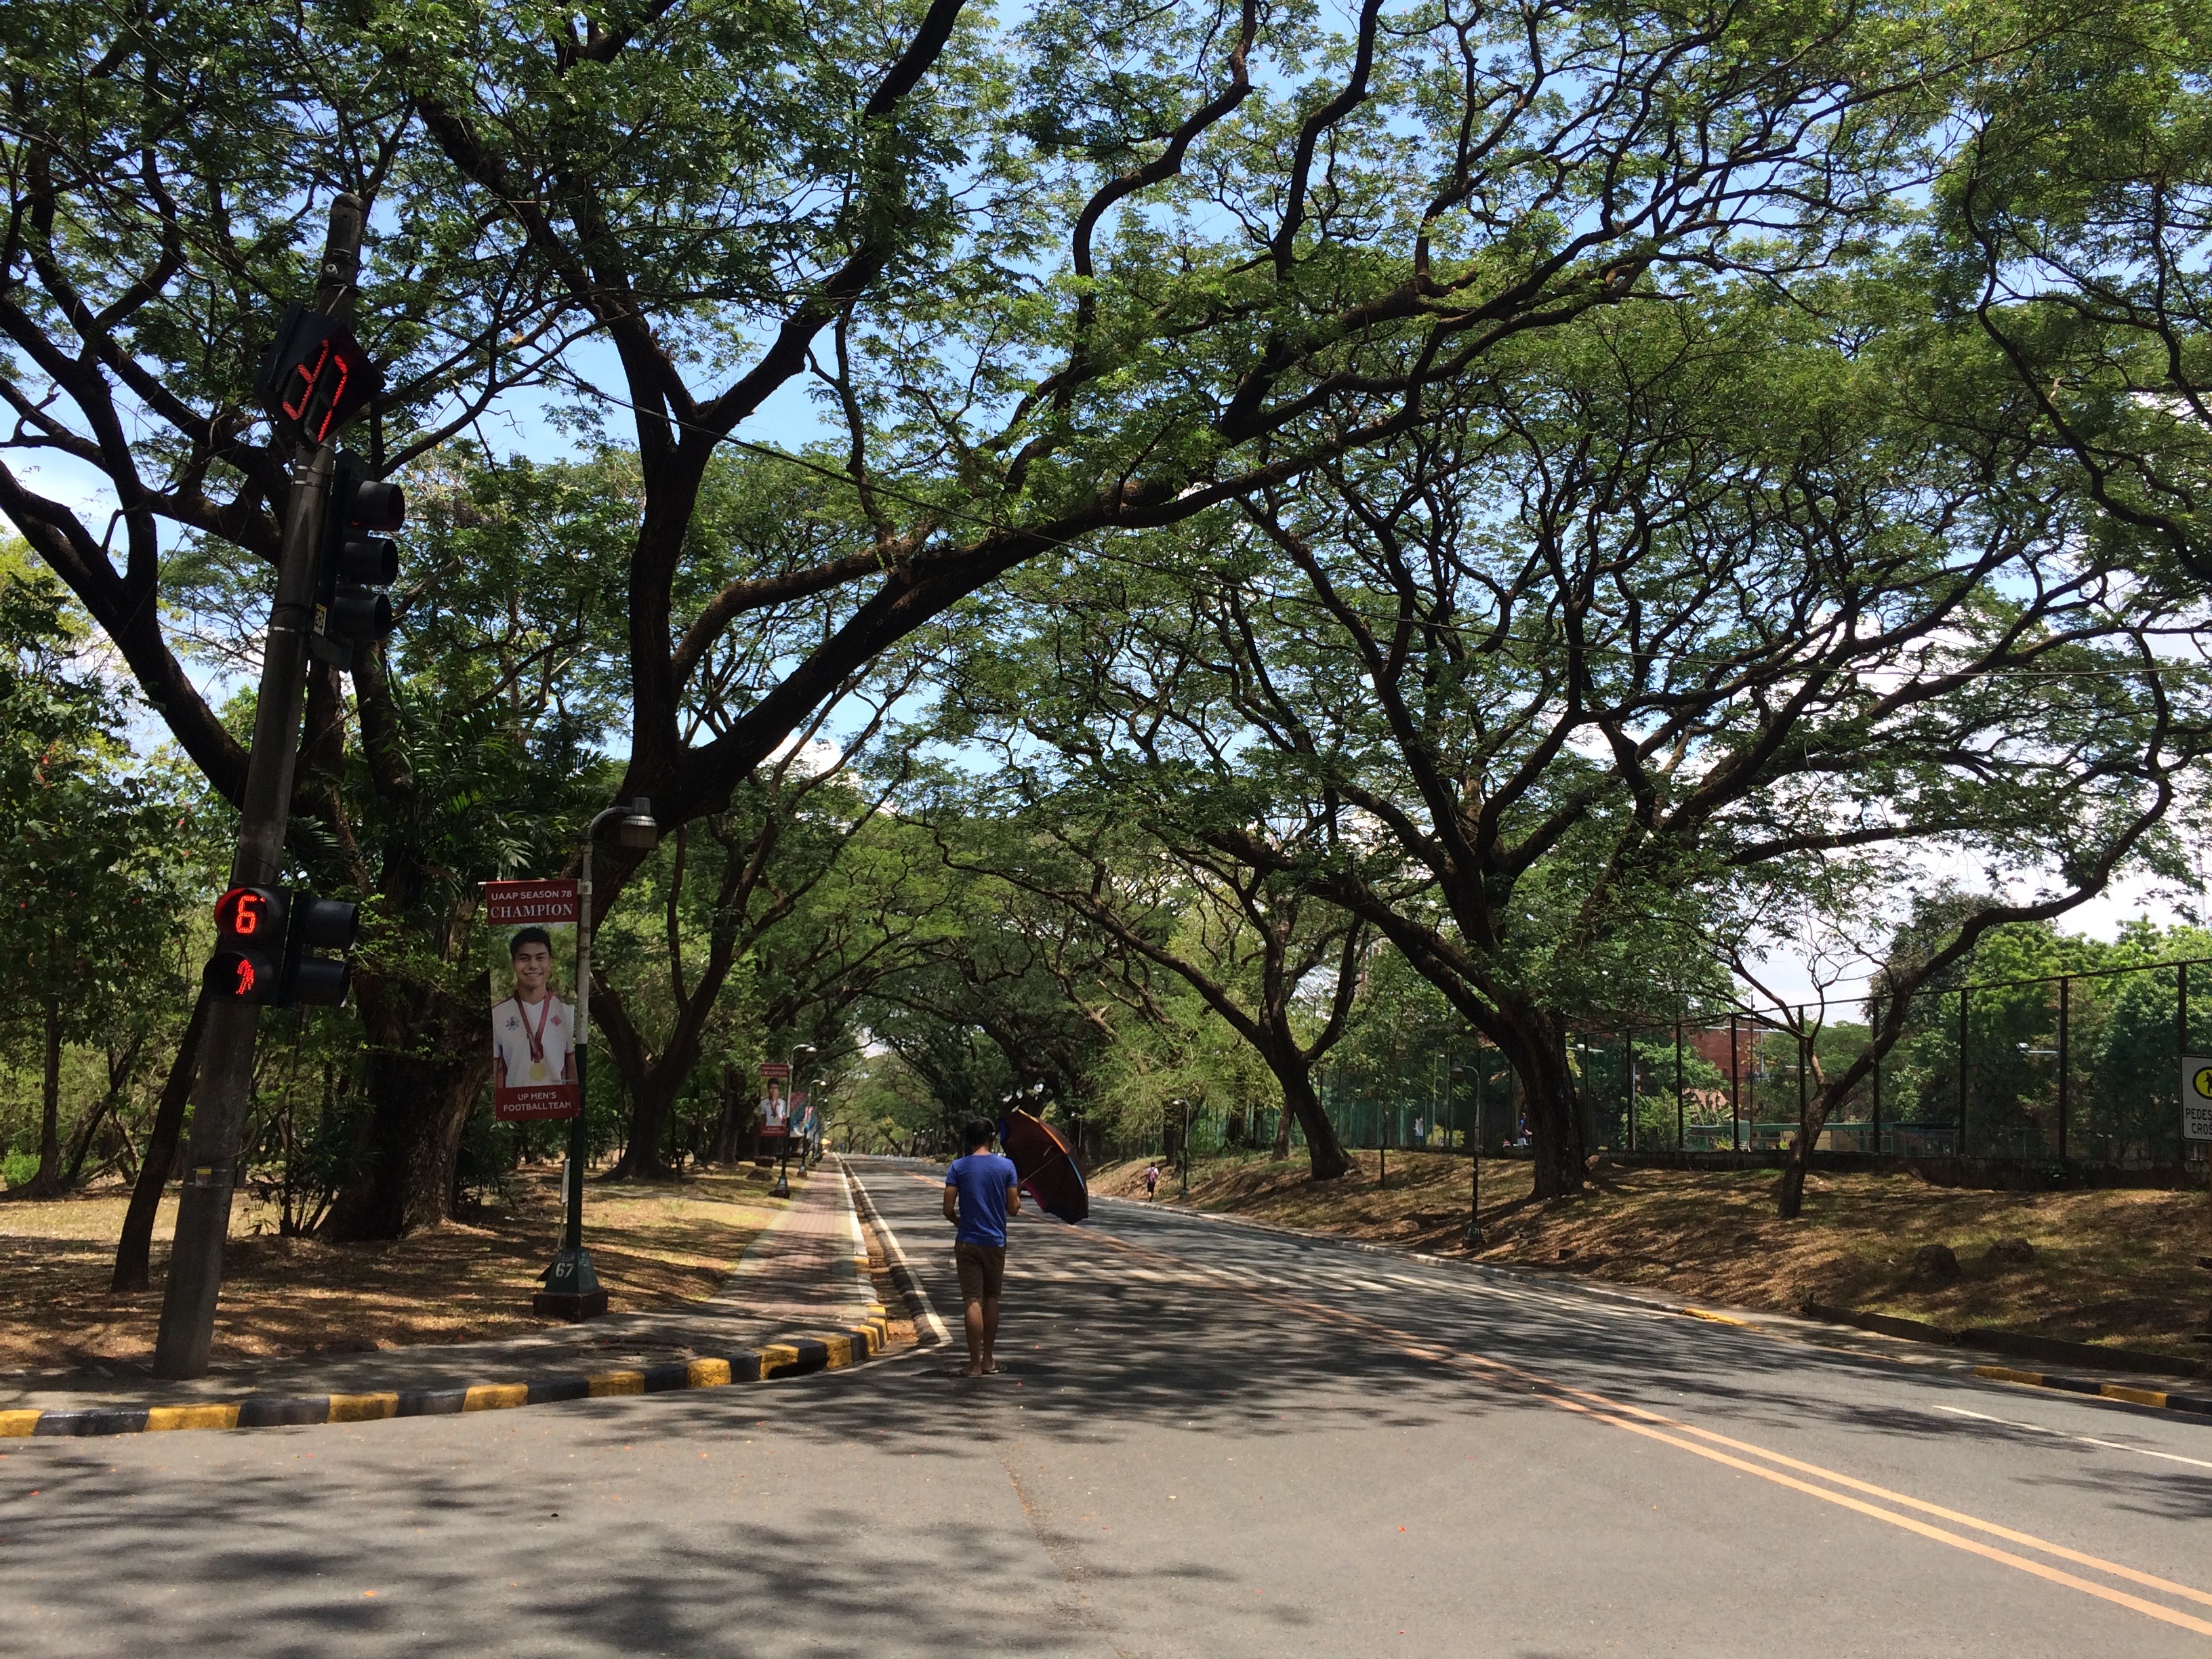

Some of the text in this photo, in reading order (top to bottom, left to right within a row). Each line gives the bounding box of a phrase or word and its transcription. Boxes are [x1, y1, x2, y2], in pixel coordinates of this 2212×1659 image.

[491, 890, 572, 901] UAAP SEASON 78
[236, 895, 266, 934] 6
[491, 903, 573, 918] CHAMPION
[531, 1091, 556, 1099] MEN'S
[504, 1101, 571, 1111] FOOTBALL TEAM
[2186, 1108, 2212, 1120] PEDES
[2191, 1122, 2212, 1135] CROS
[556, 1263, 575, 1278] 67
